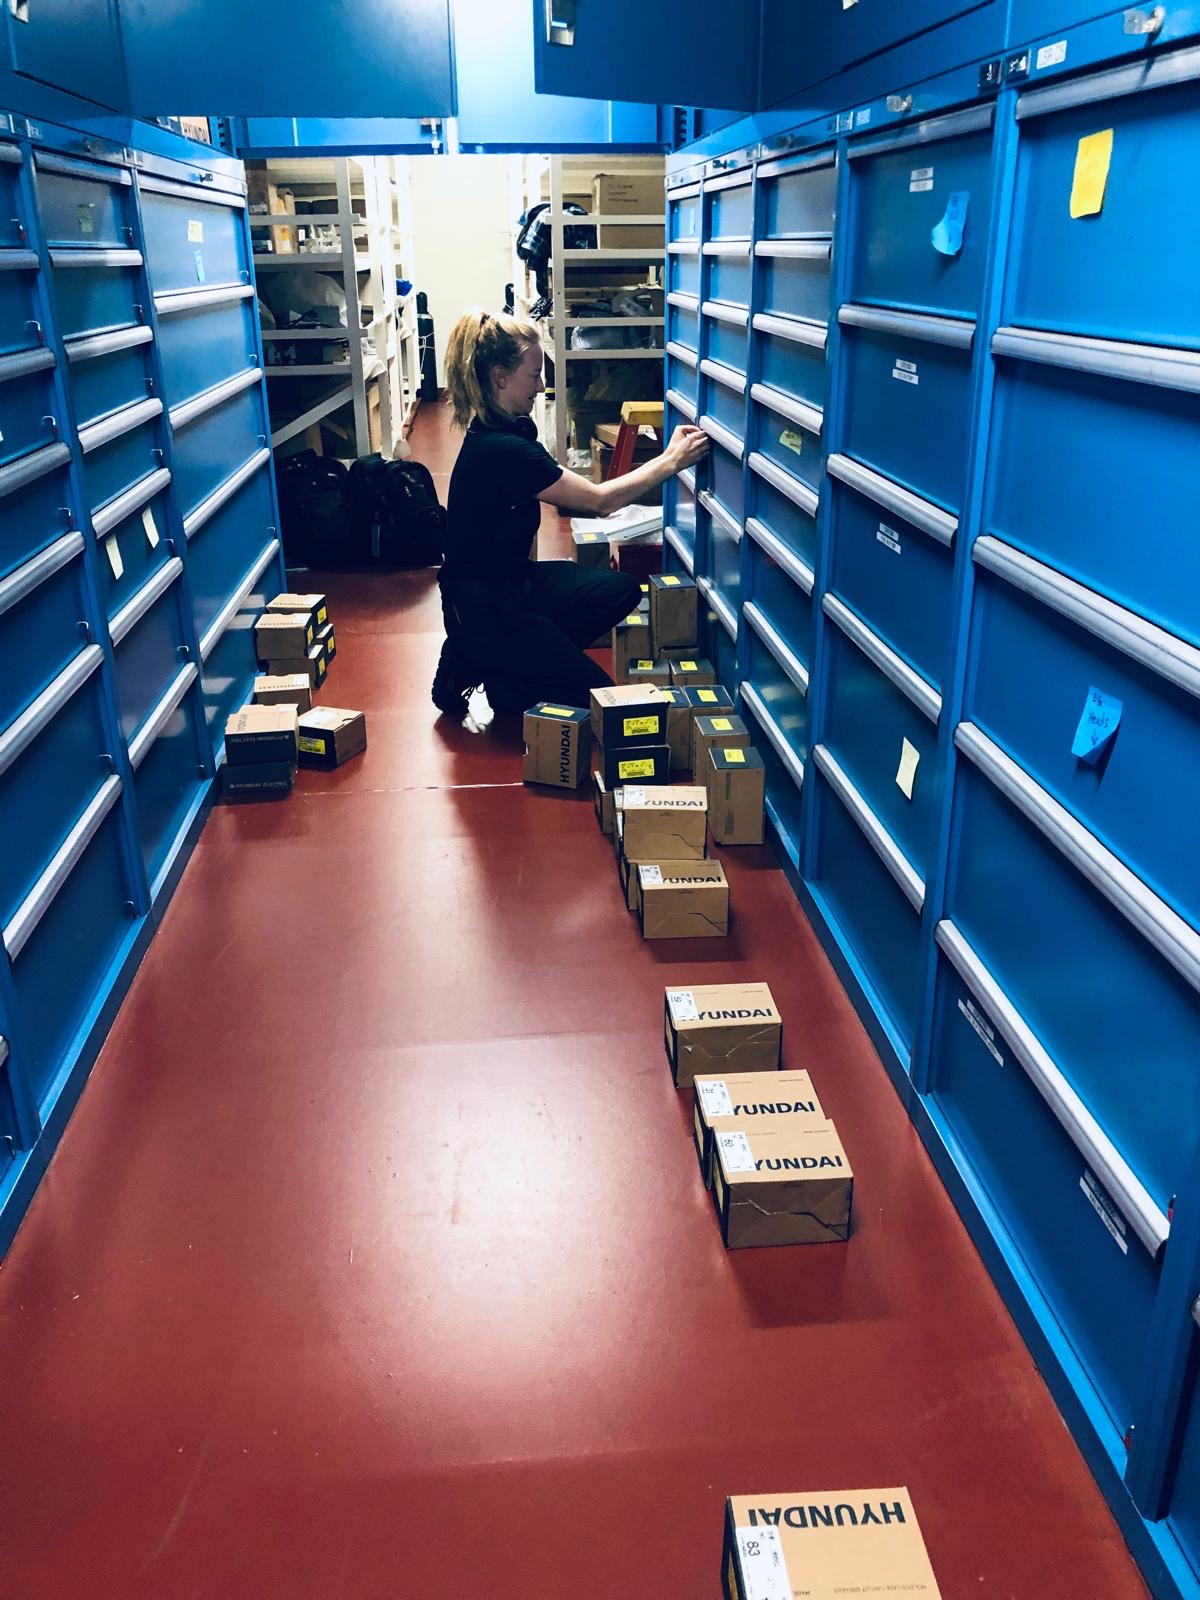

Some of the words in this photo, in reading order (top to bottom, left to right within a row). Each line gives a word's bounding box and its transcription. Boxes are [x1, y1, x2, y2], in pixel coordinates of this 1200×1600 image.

[560, 724, 571, 784] HYUNDAI
[663, 876, 722, 884] YUNDAI
[698, 1008, 772, 1020] YUNDAI
[733, 1101, 816, 1116] YUNDAI
[755, 1155, 843, 1171] YUNDAI
[748, 1502, 906, 1528] HYUNDAI
[746, 1540, 761, 1557] 83
